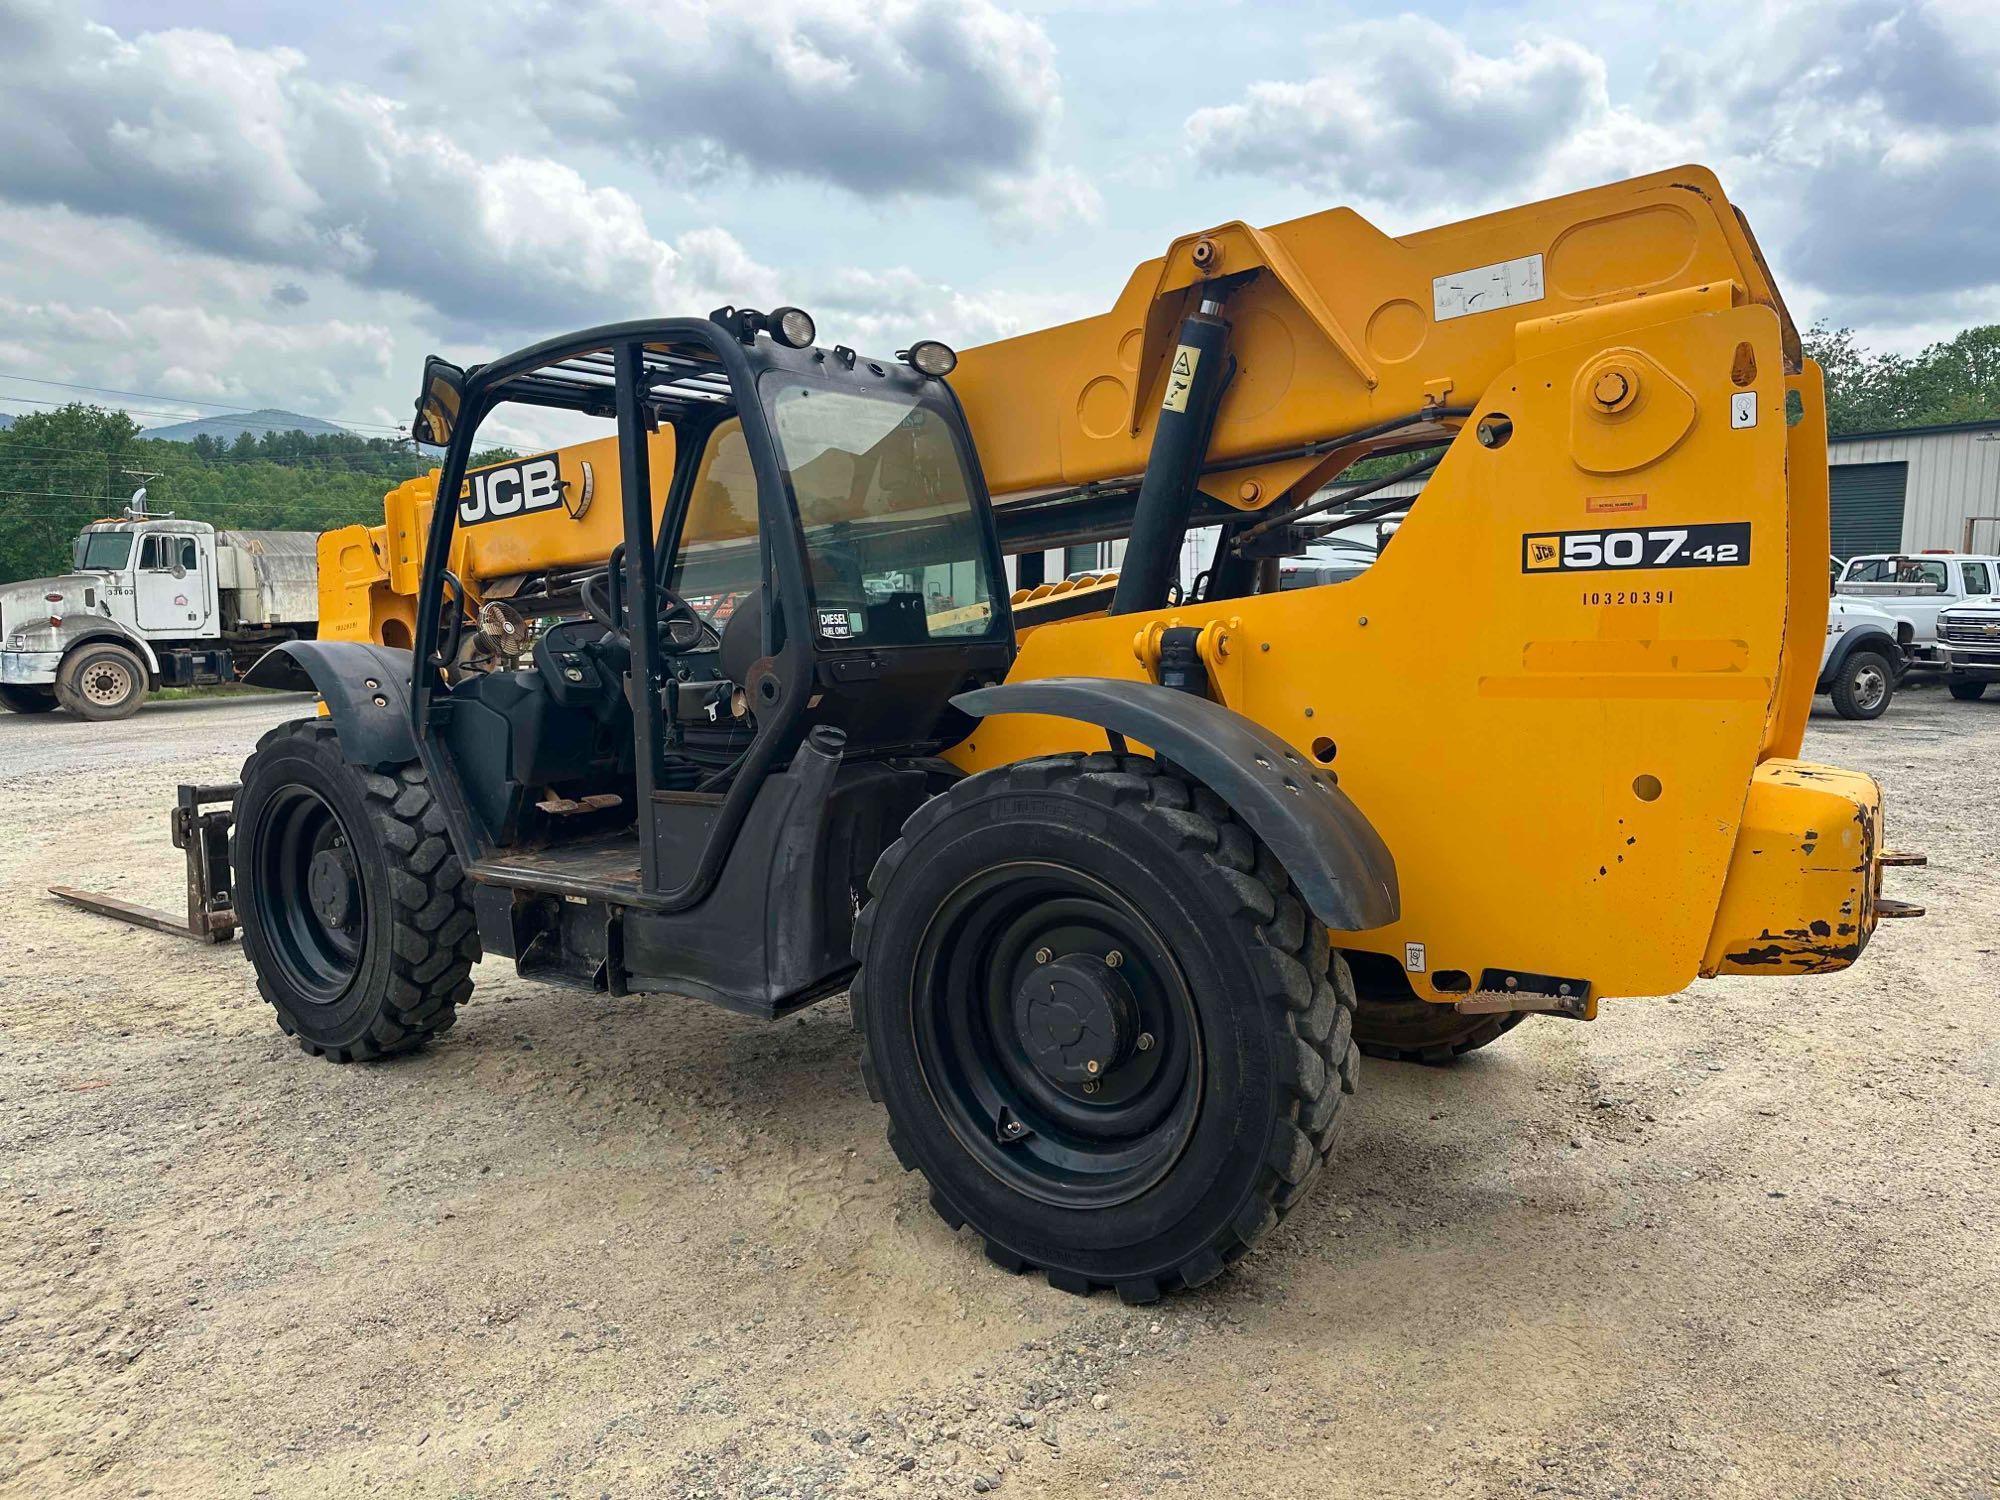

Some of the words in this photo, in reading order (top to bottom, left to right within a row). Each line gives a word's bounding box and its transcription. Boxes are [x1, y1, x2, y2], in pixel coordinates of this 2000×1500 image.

[460, 459, 560, 522] JCB
[1532, 543, 1556, 563] JCB
[1563, 530, 1739, 568] 507-42
[1583, 590, 1673, 606] 10320391
[820, 613, 848, 625] DIESEL
[822, 626, 835, 635] FUEL
[835, 626, 848, 635] ONLY
